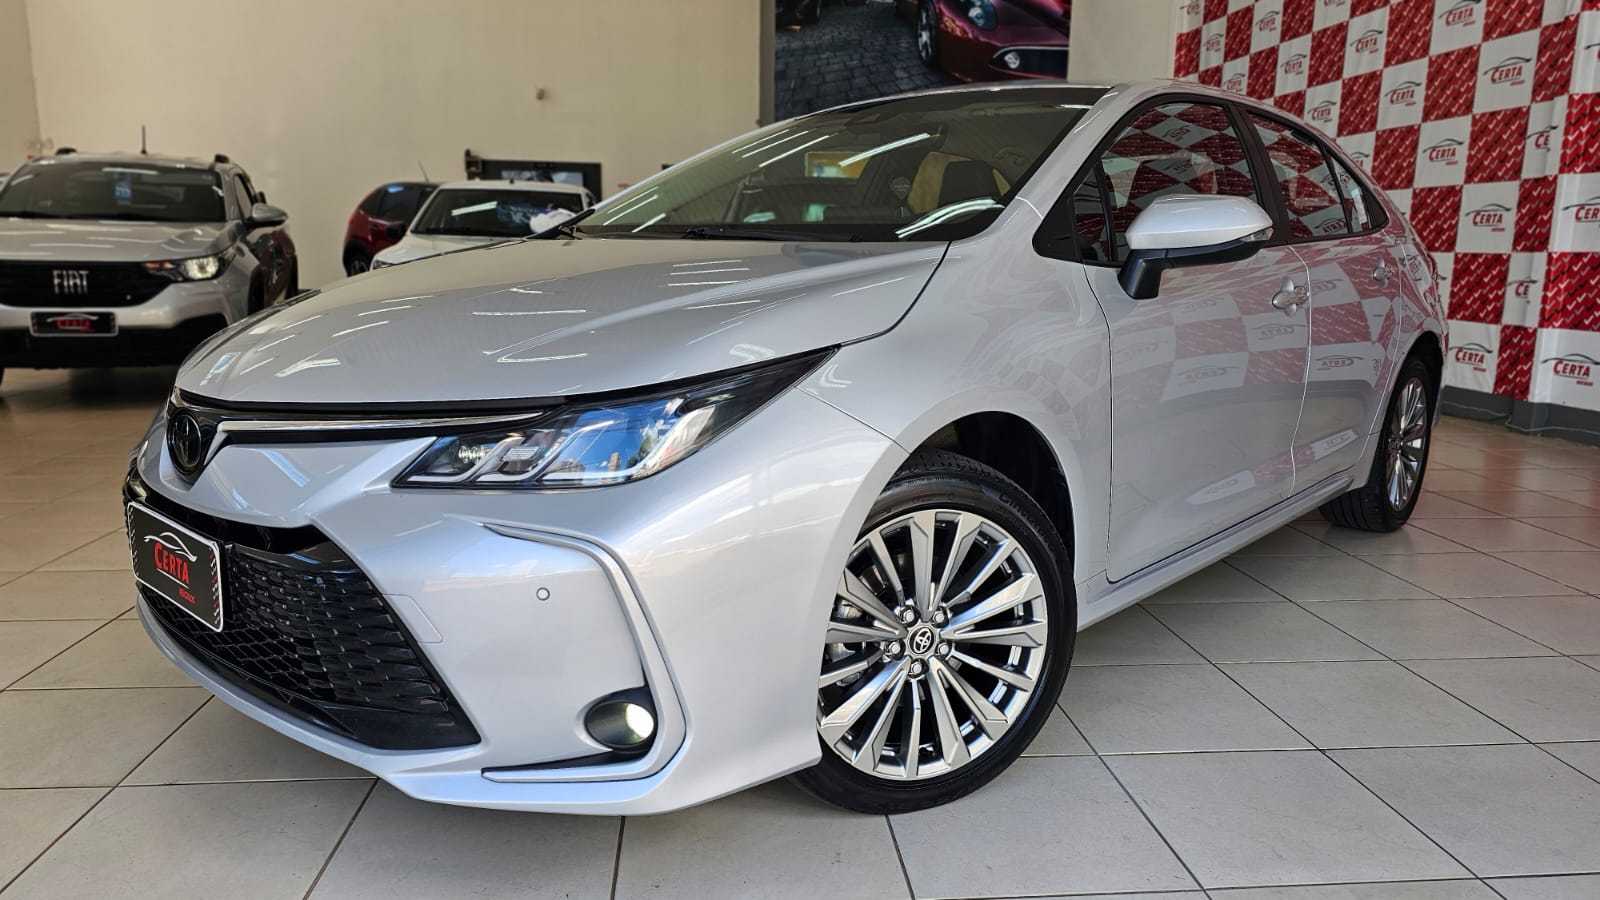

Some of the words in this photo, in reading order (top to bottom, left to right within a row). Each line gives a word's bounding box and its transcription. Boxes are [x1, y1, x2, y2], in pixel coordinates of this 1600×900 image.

[1446, 7, 1473, 26] CERTA
[1356, 37, 1377, 52] CERTA
[1491, 66, 1523, 84] CERTA
[1390, 89, 1415, 104] CERTA
[1429, 147, 1457, 162] CERTA
[1473, 212, 1503, 225] CERTA
[53, 270, 89, 295] FIAT
[1456, 349, 1485, 364] CERTA
[1553, 360, 1591, 377] CERTA
[154, 541, 190, 585] CERTA
